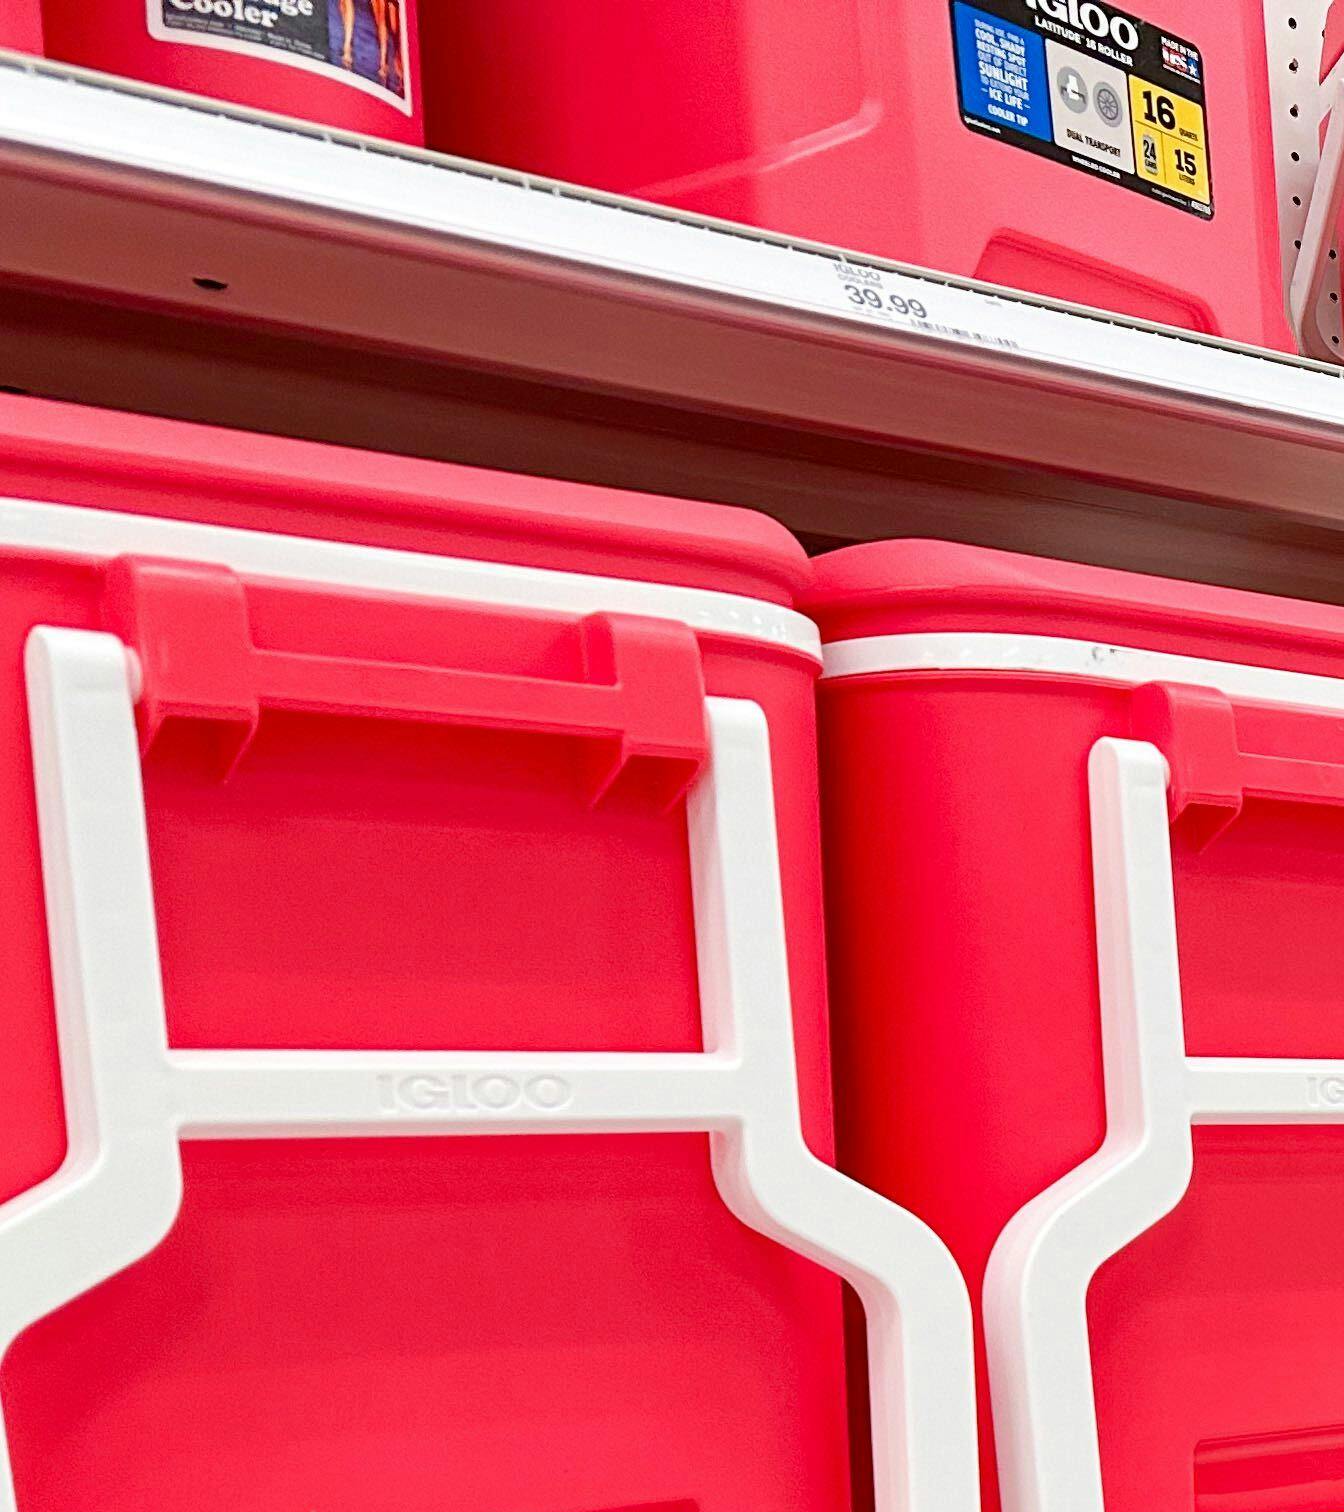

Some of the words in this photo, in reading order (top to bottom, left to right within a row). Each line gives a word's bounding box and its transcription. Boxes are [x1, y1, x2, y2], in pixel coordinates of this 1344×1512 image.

[1142, 90, 1176, 131] 16
[1143, 139, 1157, 161] 24
[1174, 148, 1197, 176] 15
[844, 284, 927, 319] 39.99
[376, 1073, 573, 1112] IGLOO
